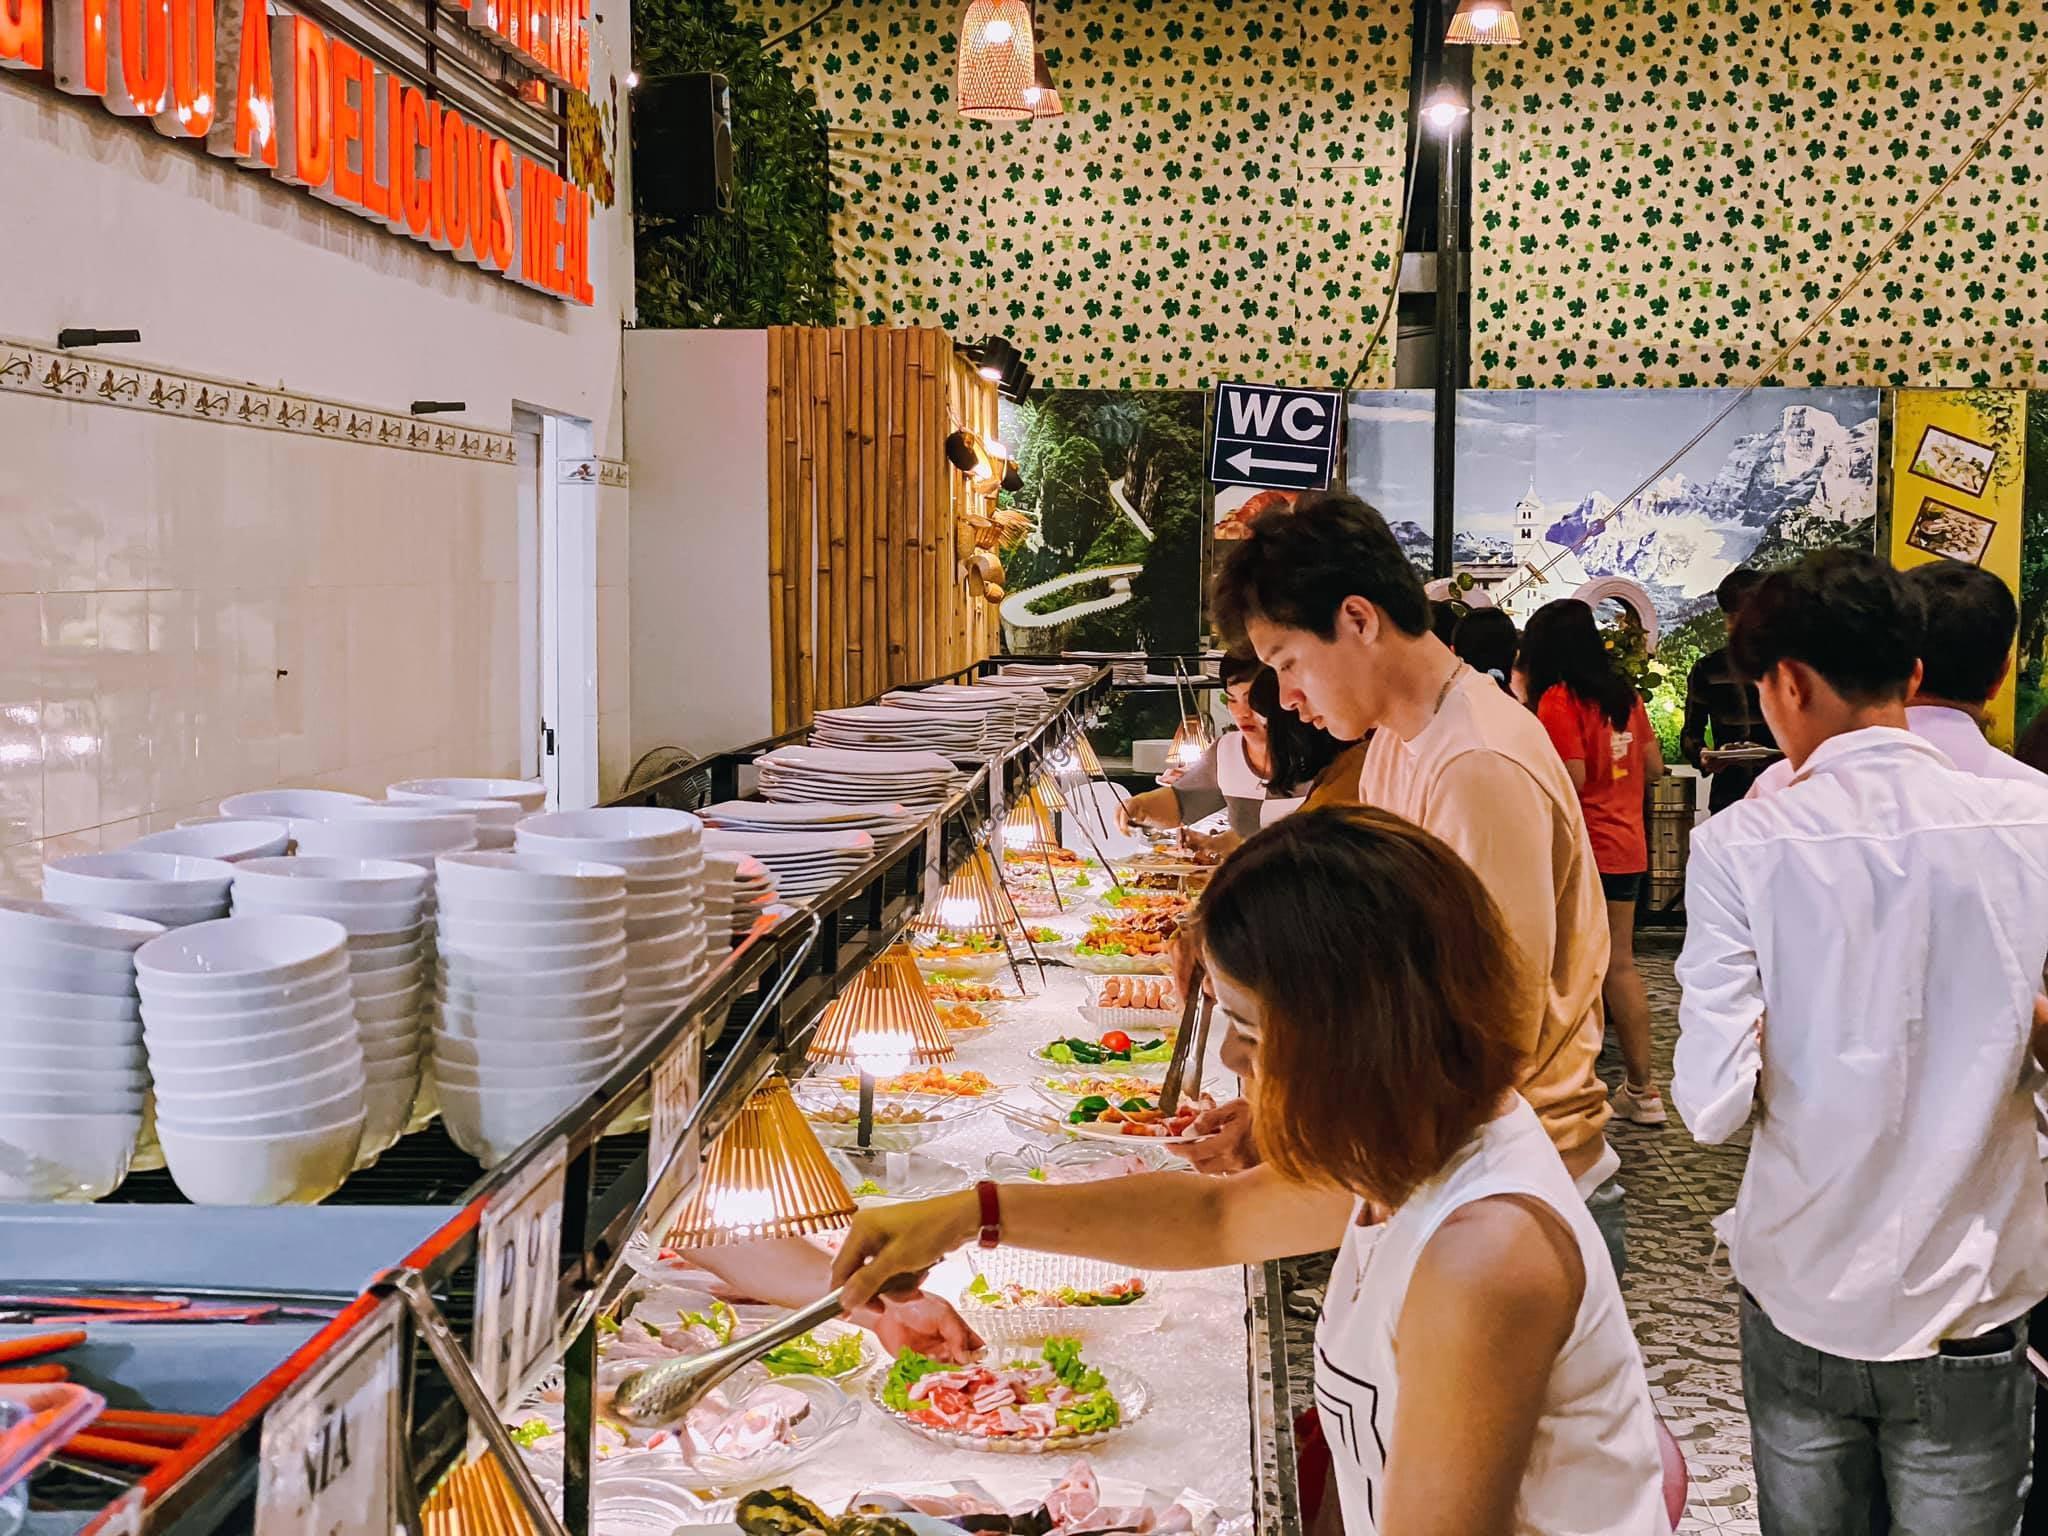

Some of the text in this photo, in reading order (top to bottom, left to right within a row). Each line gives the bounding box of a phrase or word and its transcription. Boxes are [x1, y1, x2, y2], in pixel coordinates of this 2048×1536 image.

[295, 14, 514, 270] DELICIOUS
[521, 157, 595, 305] MEAL
[1228, 391, 1327, 441] WC
